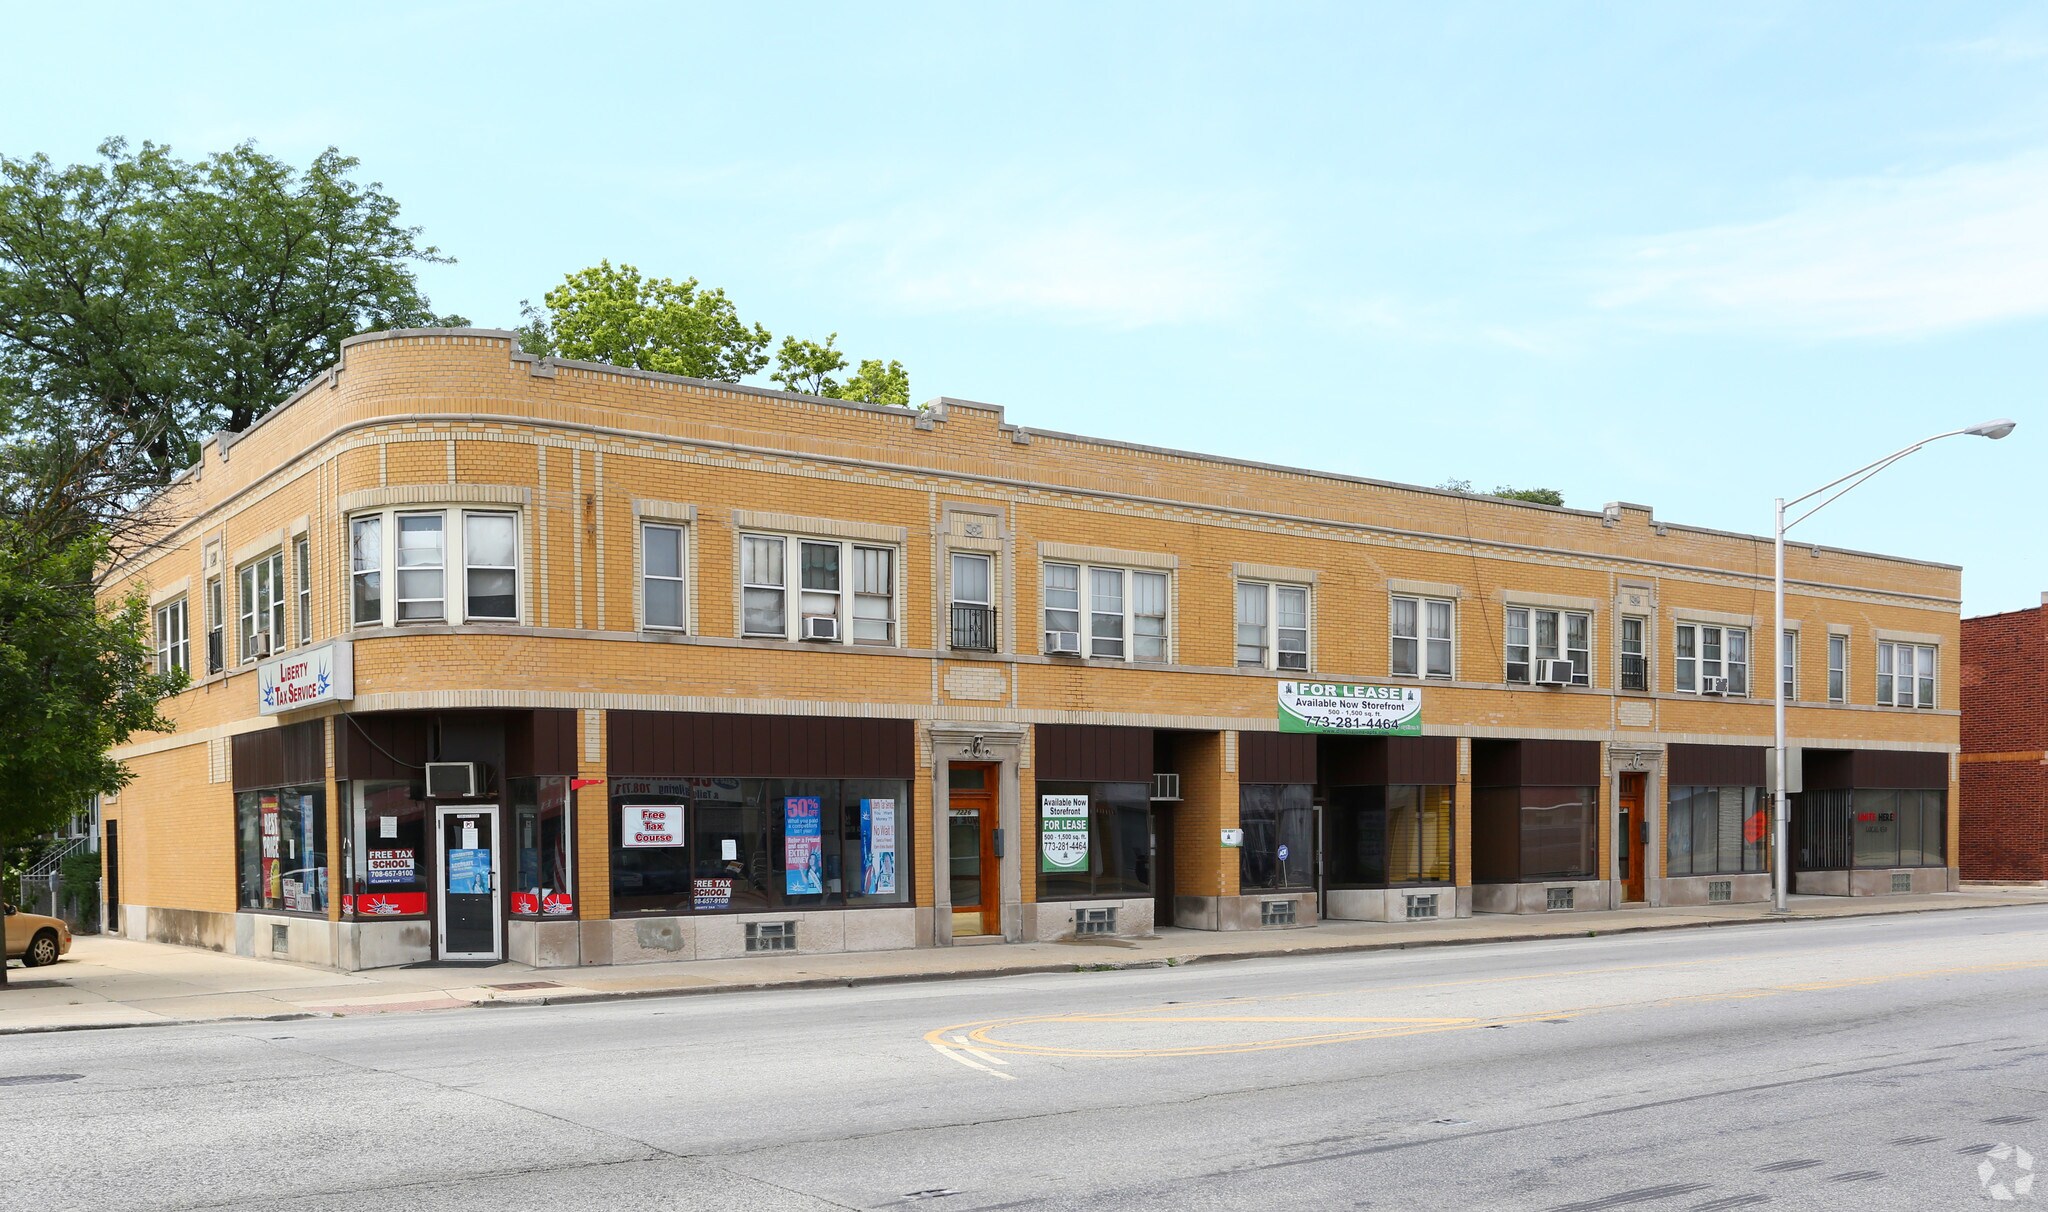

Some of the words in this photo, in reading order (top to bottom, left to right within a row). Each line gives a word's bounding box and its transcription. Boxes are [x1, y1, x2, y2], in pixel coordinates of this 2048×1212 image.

[280, 662, 308, 682] LIBERTY
[275, 686, 288, 706] TAX
[288, 683, 317, 703] SERVICE
[1299, 683, 1338, 697] FOR
[1343, 685, 1400, 700] LEASE
[1296, 697, 1337, 708] Available
[1339, 700, 1359, 709] Now
[1361, 700, 1405, 711] Storefront
[1304, 715, 1399, 729] 773-281-4464
[1043, 798, 1072, 807] Available
[1072, 799, 1087, 807] Now
[787, 798, 819, 818] 50%
[1049, 807, 1081, 815] Storefront
[642, 810, 665, 820] Free
[643, 821, 665, 831] Tax
[1044, 820, 1060, 830] FOR
[1061, 820, 1087, 830] LEASE
[635, 832, 673, 843] Course
[1057, 833, 1072, 841] 1,500
[1044, 841, 1087, 851] 773-281-4464
[369, 850, 393, 859] FREE
[395, 850, 413, 858] TAX
[788, 849, 809, 857] EXTRA
[372, 860, 411, 869] SCHOOL
[714, 880, 731, 888] TAX
[694, 889, 727, 897] SCHOOL
